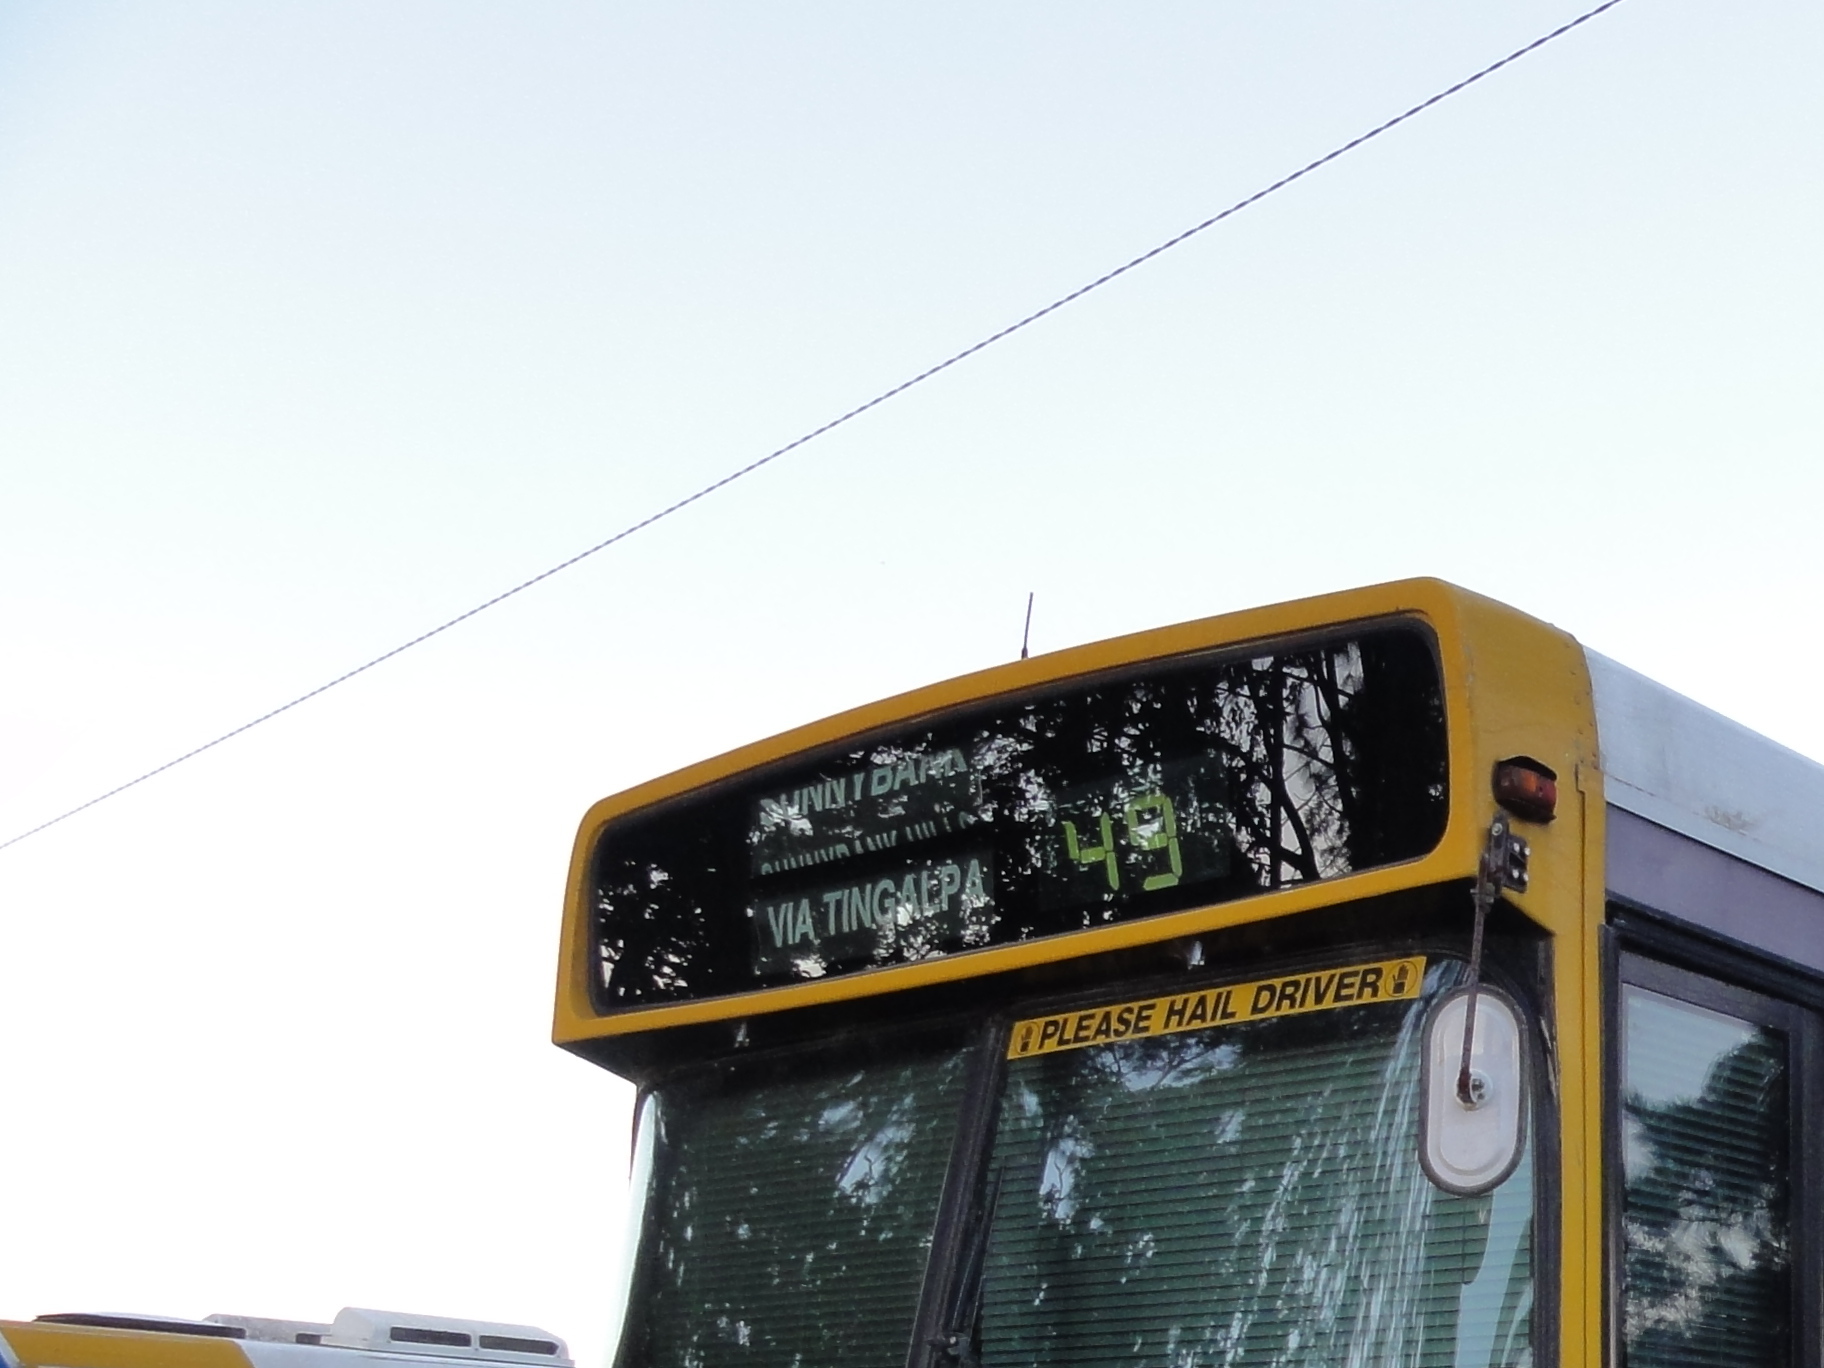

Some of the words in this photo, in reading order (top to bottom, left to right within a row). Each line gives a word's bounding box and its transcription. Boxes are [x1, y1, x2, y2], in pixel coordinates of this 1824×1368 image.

[1063, 794, 1182, 891] 49
[767, 899, 818, 948] VIA
[825, 858, 986, 937] TINGALPA
[1038, 1003, 1156, 1050] PLEASE
[1163, 989, 1237, 1031] HAIL
[1251, 967, 1383, 1015] DRIVER
